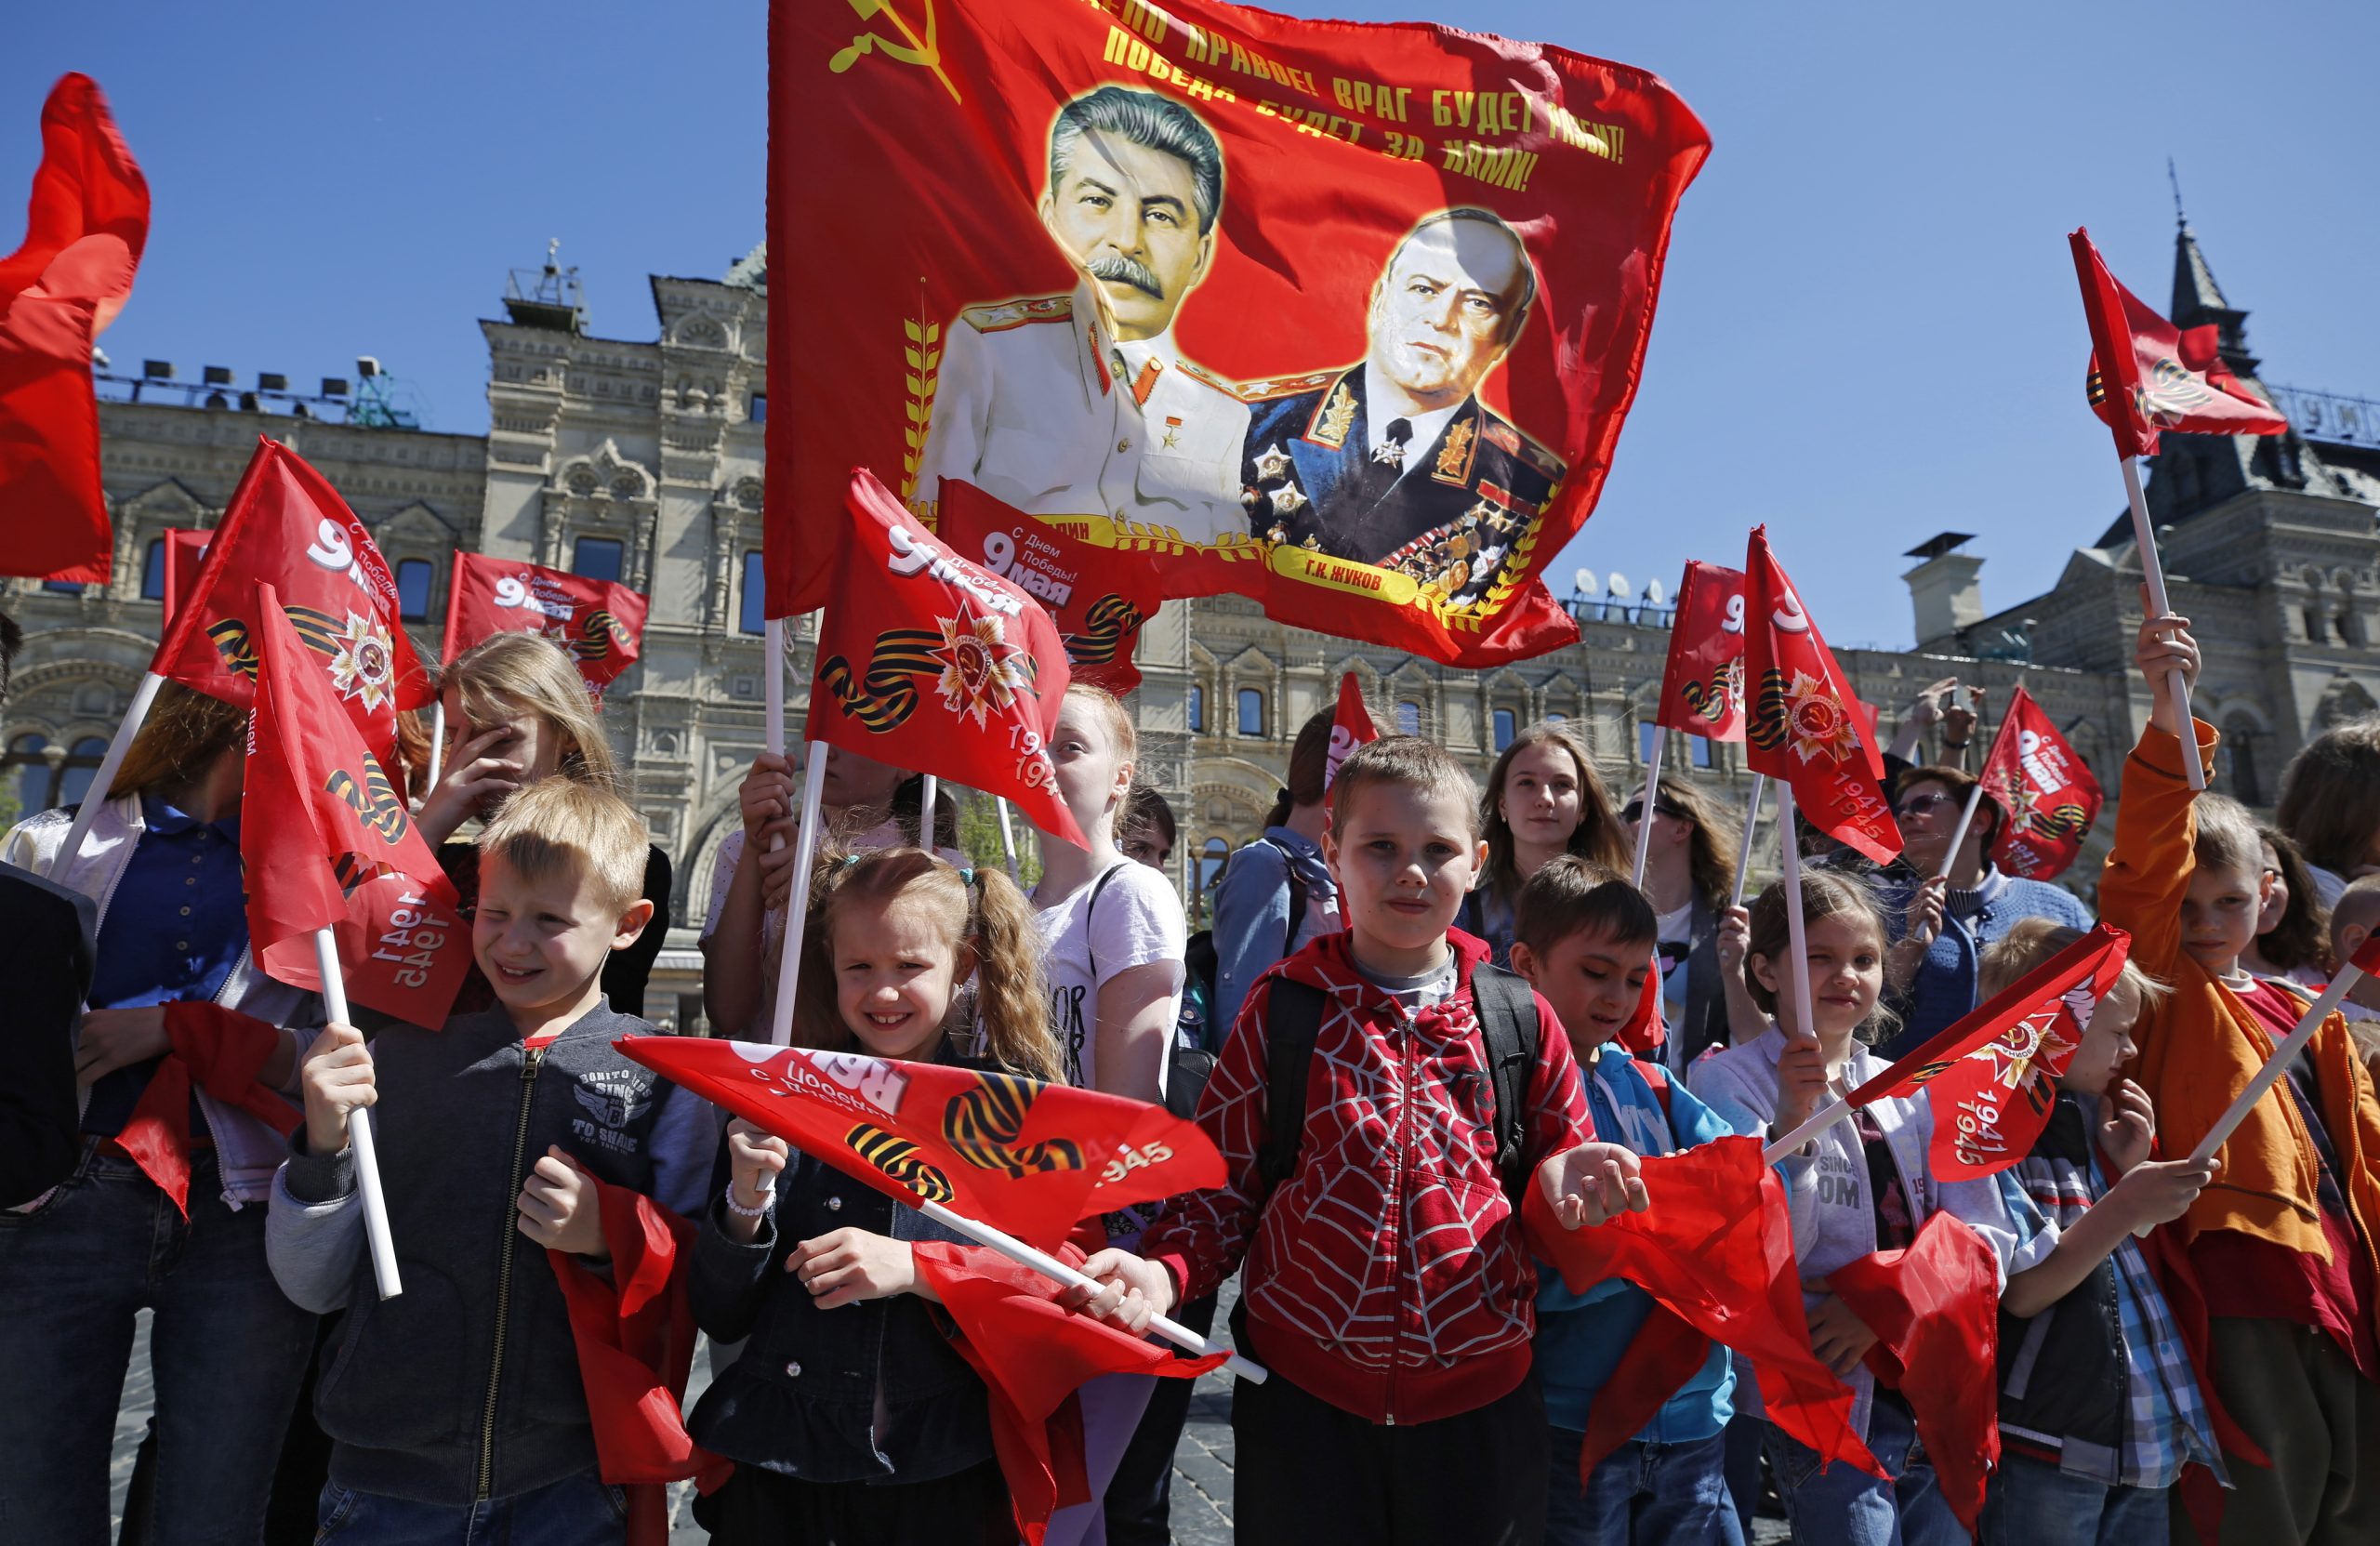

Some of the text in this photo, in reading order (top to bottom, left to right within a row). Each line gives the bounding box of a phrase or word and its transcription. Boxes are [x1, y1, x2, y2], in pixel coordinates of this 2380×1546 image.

[1185, 21, 1320, 98] ПРАВОЕ!
[1333, 76, 1412, 123] ВРАГ
[1433, 89, 1532, 136] БУДЕТ
[1104, 25, 1539, 192] ПОБЕДА БУДЕТ ЗА НАМИ!
[307, 518, 354, 570] 9
[1012, 527, 1061, 559] С Днем
[983, 532, 1015, 576] 9
[1007, 562, 1073, 606] мая
[1022, 550, 1078, 584] Победы!
[1330, 565, 1382, 590] ЖУКОВ
[494, 577, 575, 622] 9 мая
[1721, 594, 1745, 632] 9
[1833, 772, 1889, 819] 1941
[2021, 753, 2062, 795] мая
[1829, 791, 1885, 839] 1945
[2008, 839, 2041, 865] 1941
[579, 1070, 629, 1085] BONITO
[573, 1118, 595, 1137] TO
[1954, 1100, 1985, 1165] 1945
[1976, 1090, 2008, 1152] 1941
[1094, 1140, 1174, 1188] 945
